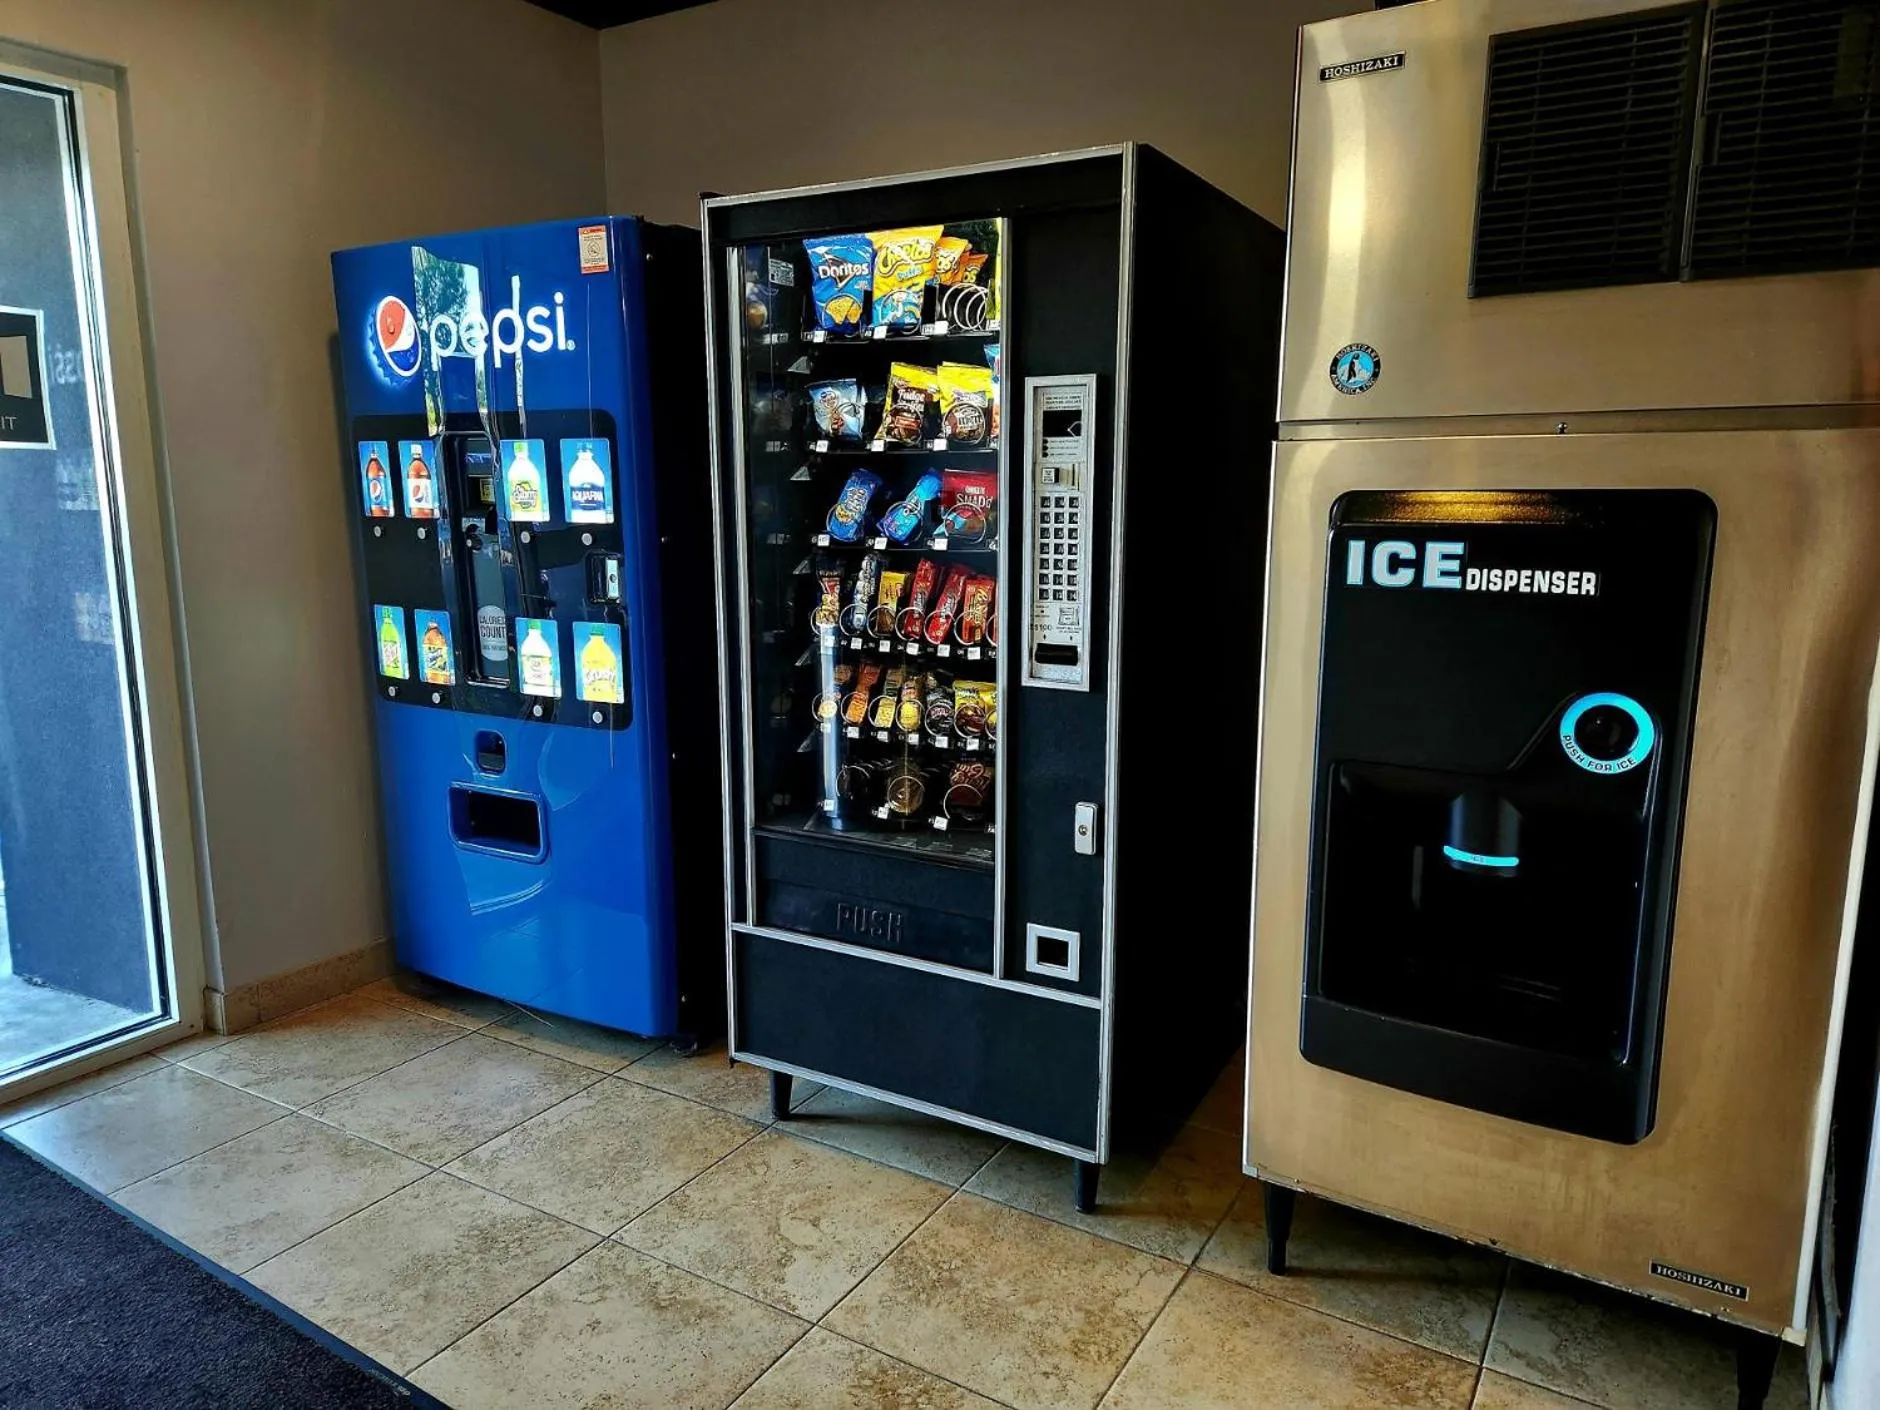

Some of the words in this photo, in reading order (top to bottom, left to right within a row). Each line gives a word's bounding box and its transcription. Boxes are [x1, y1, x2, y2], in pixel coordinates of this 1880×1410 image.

[1324, 56, 1399, 79] HOSHIZAKI
[819, 263, 869, 279] Doritos
[429, 291, 565, 372] pepsi
[1346, 540, 1464, 589] ICE
[1466, 568, 1597, 596] DISPENSER
[1562, 734, 1584, 763] PUSH
[1587, 760, 1612, 771] FOR
[1617, 757, 1635, 769] ICE
[836, 902, 901, 943] PUSH
[1656, 1265, 1741, 1295] HOSHIZAKI
